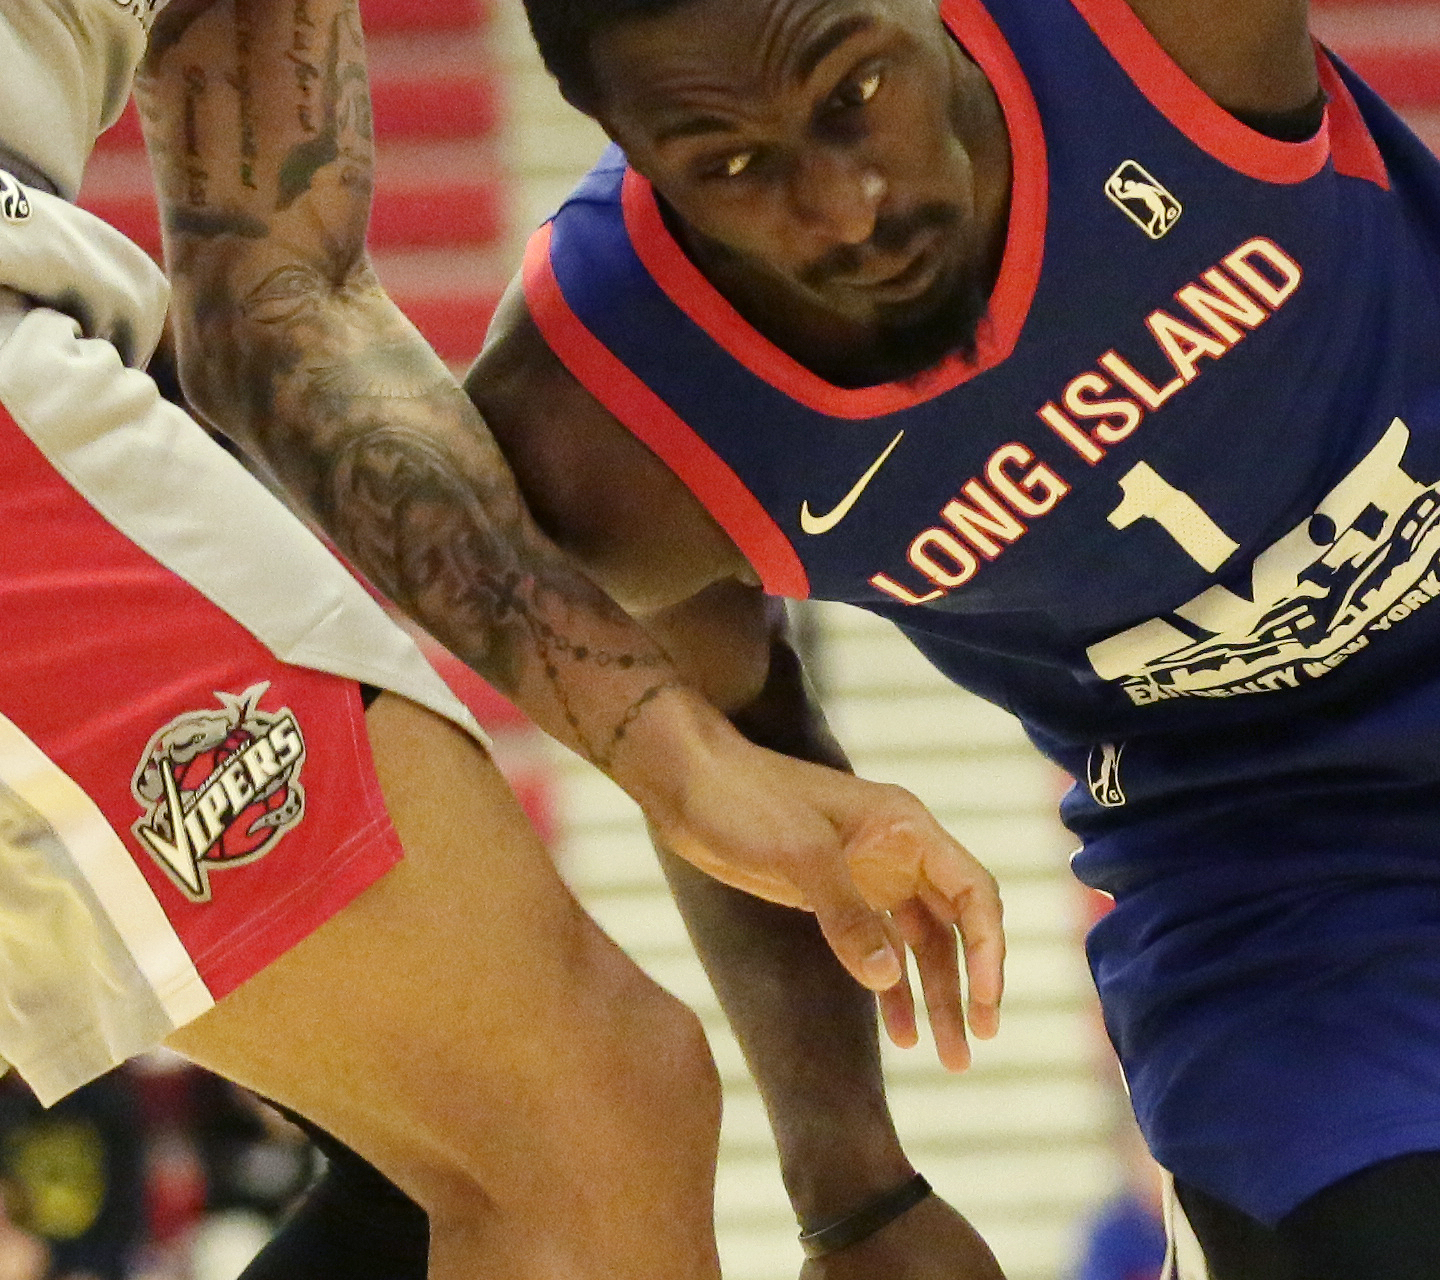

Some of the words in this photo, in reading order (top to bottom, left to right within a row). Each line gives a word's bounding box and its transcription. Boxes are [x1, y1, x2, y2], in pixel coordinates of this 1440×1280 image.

[871, 440, 1070, 606] LONG
[1037, 236, 1303, 465] ISLAND
[1106, 460, 1241, 573] 1
[141, 716, 304, 895] VIPERS
